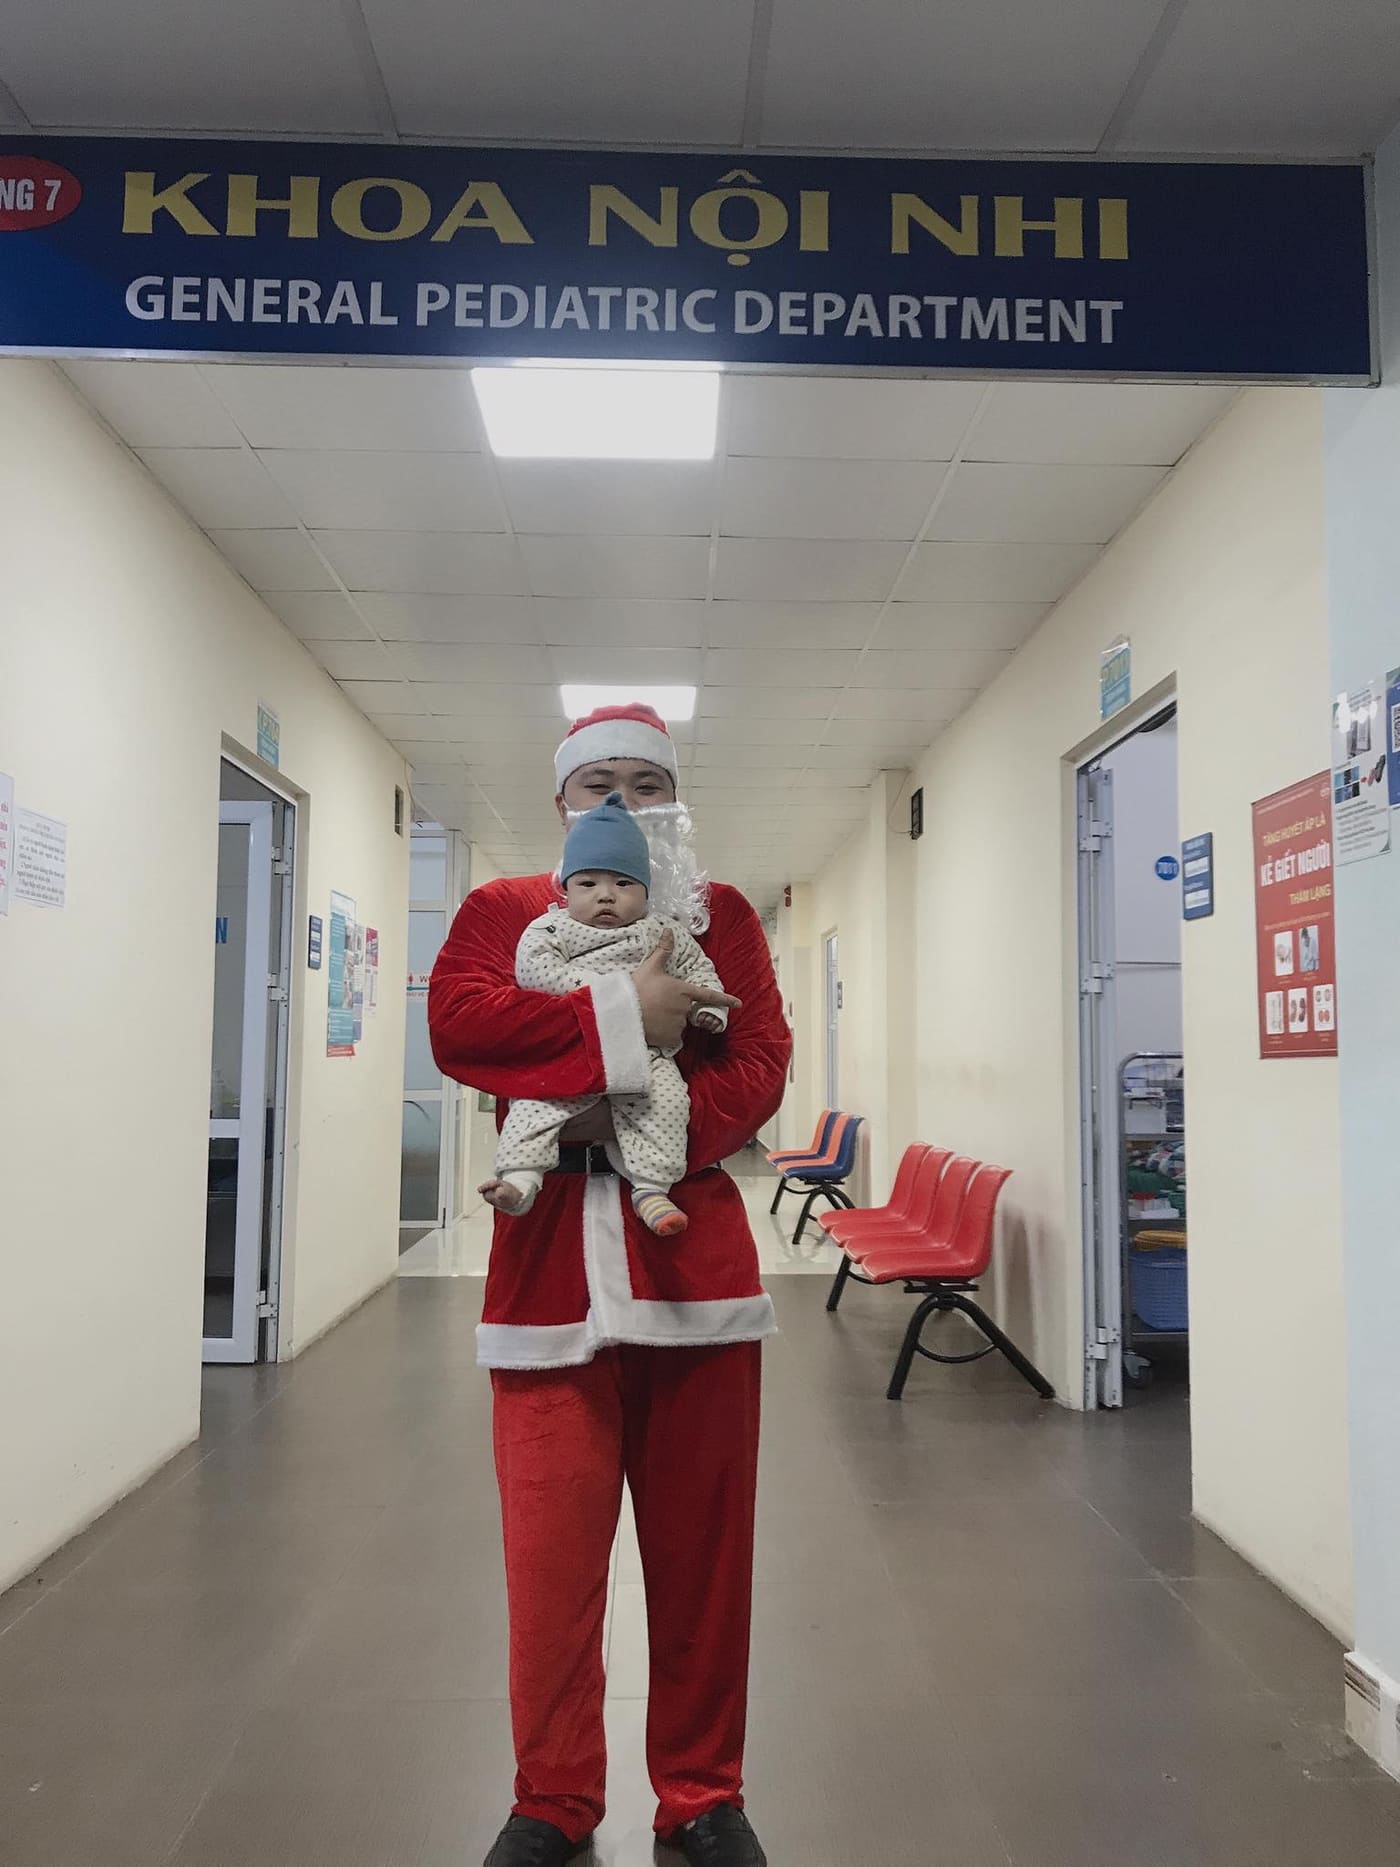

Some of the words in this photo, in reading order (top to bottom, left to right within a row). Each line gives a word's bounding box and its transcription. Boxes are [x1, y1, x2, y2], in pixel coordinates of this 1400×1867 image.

[44, 179, 62, 211] 7
[122, 171, 534, 245] KHOA
[587, 169, 829, 266] NỘI
[891, 192, 1128, 260] NHI
[125, 275, 398, 326] GENERAL
[416, 282, 718, 335] PEDIATRIC
[735, 290, 1124, 344] DEPARTMENT
